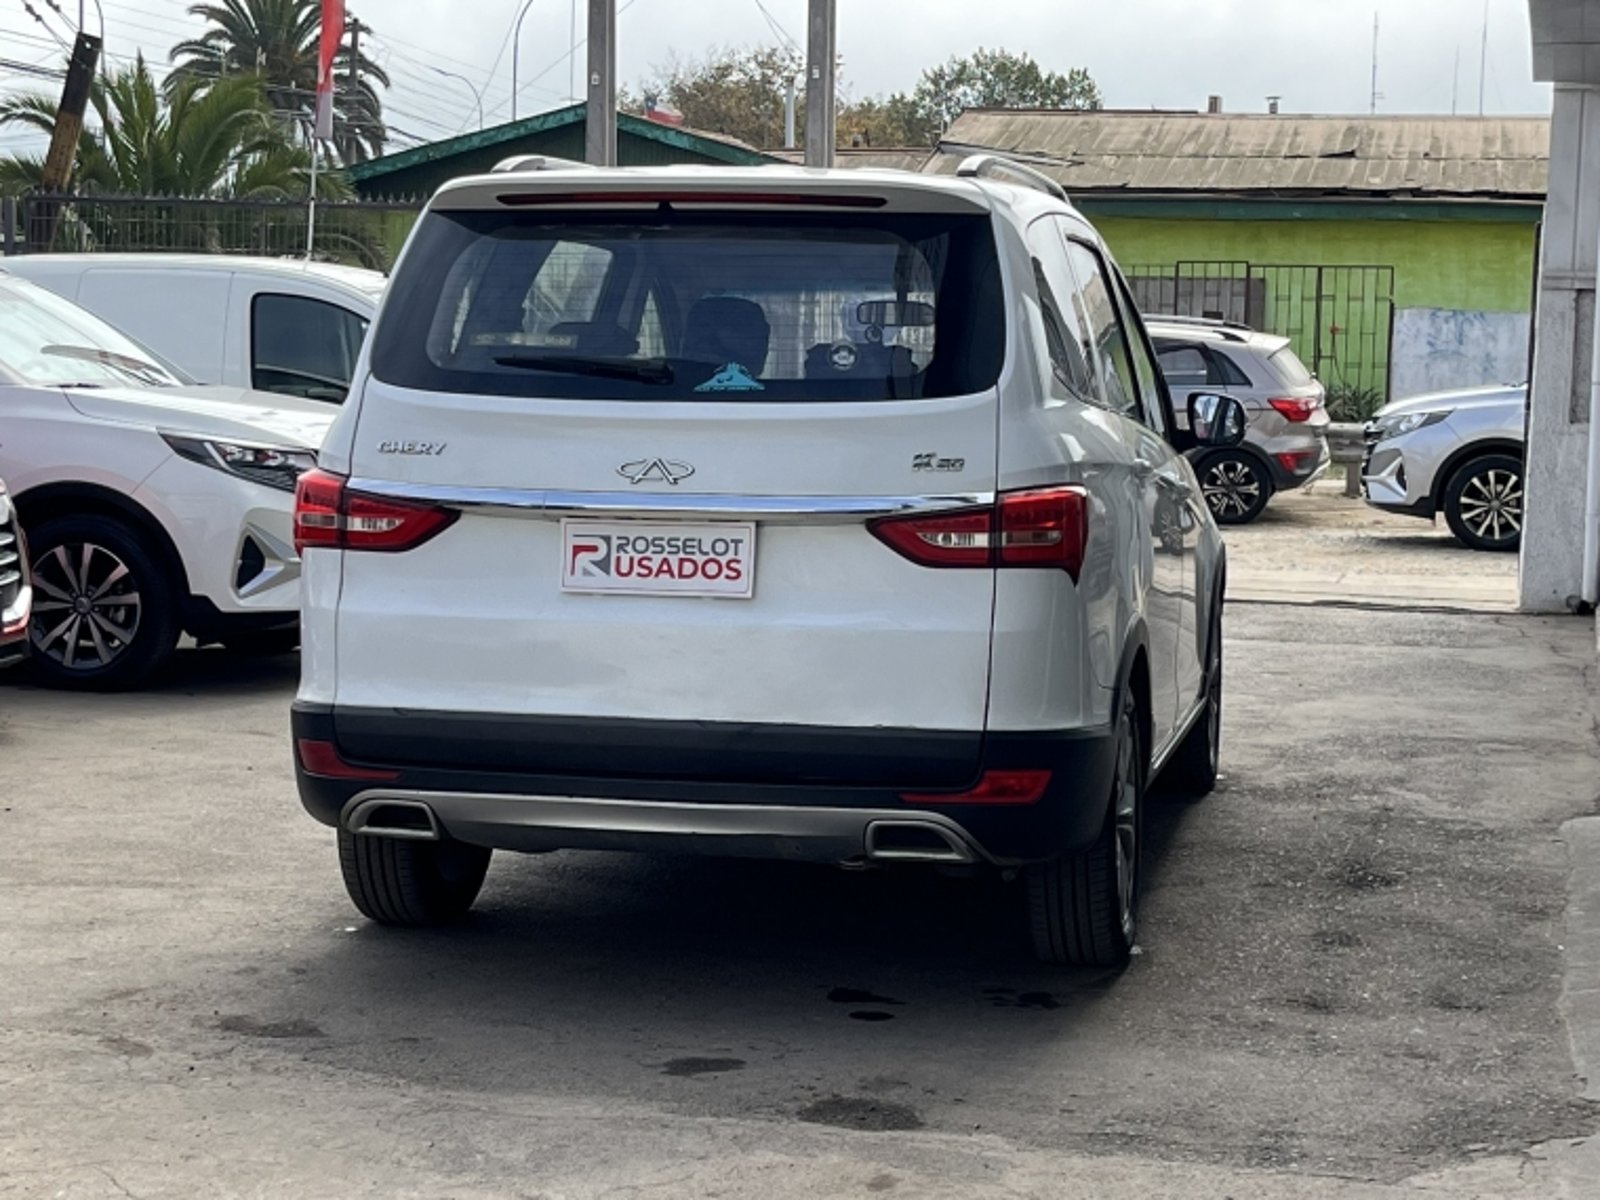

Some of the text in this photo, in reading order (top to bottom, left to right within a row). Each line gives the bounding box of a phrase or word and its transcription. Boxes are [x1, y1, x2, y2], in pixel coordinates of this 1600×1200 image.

[376, 440, 447, 456] CHERY
[616, 536, 743, 557] ROSSELOT
[614, 556, 742, 581] USADOS
